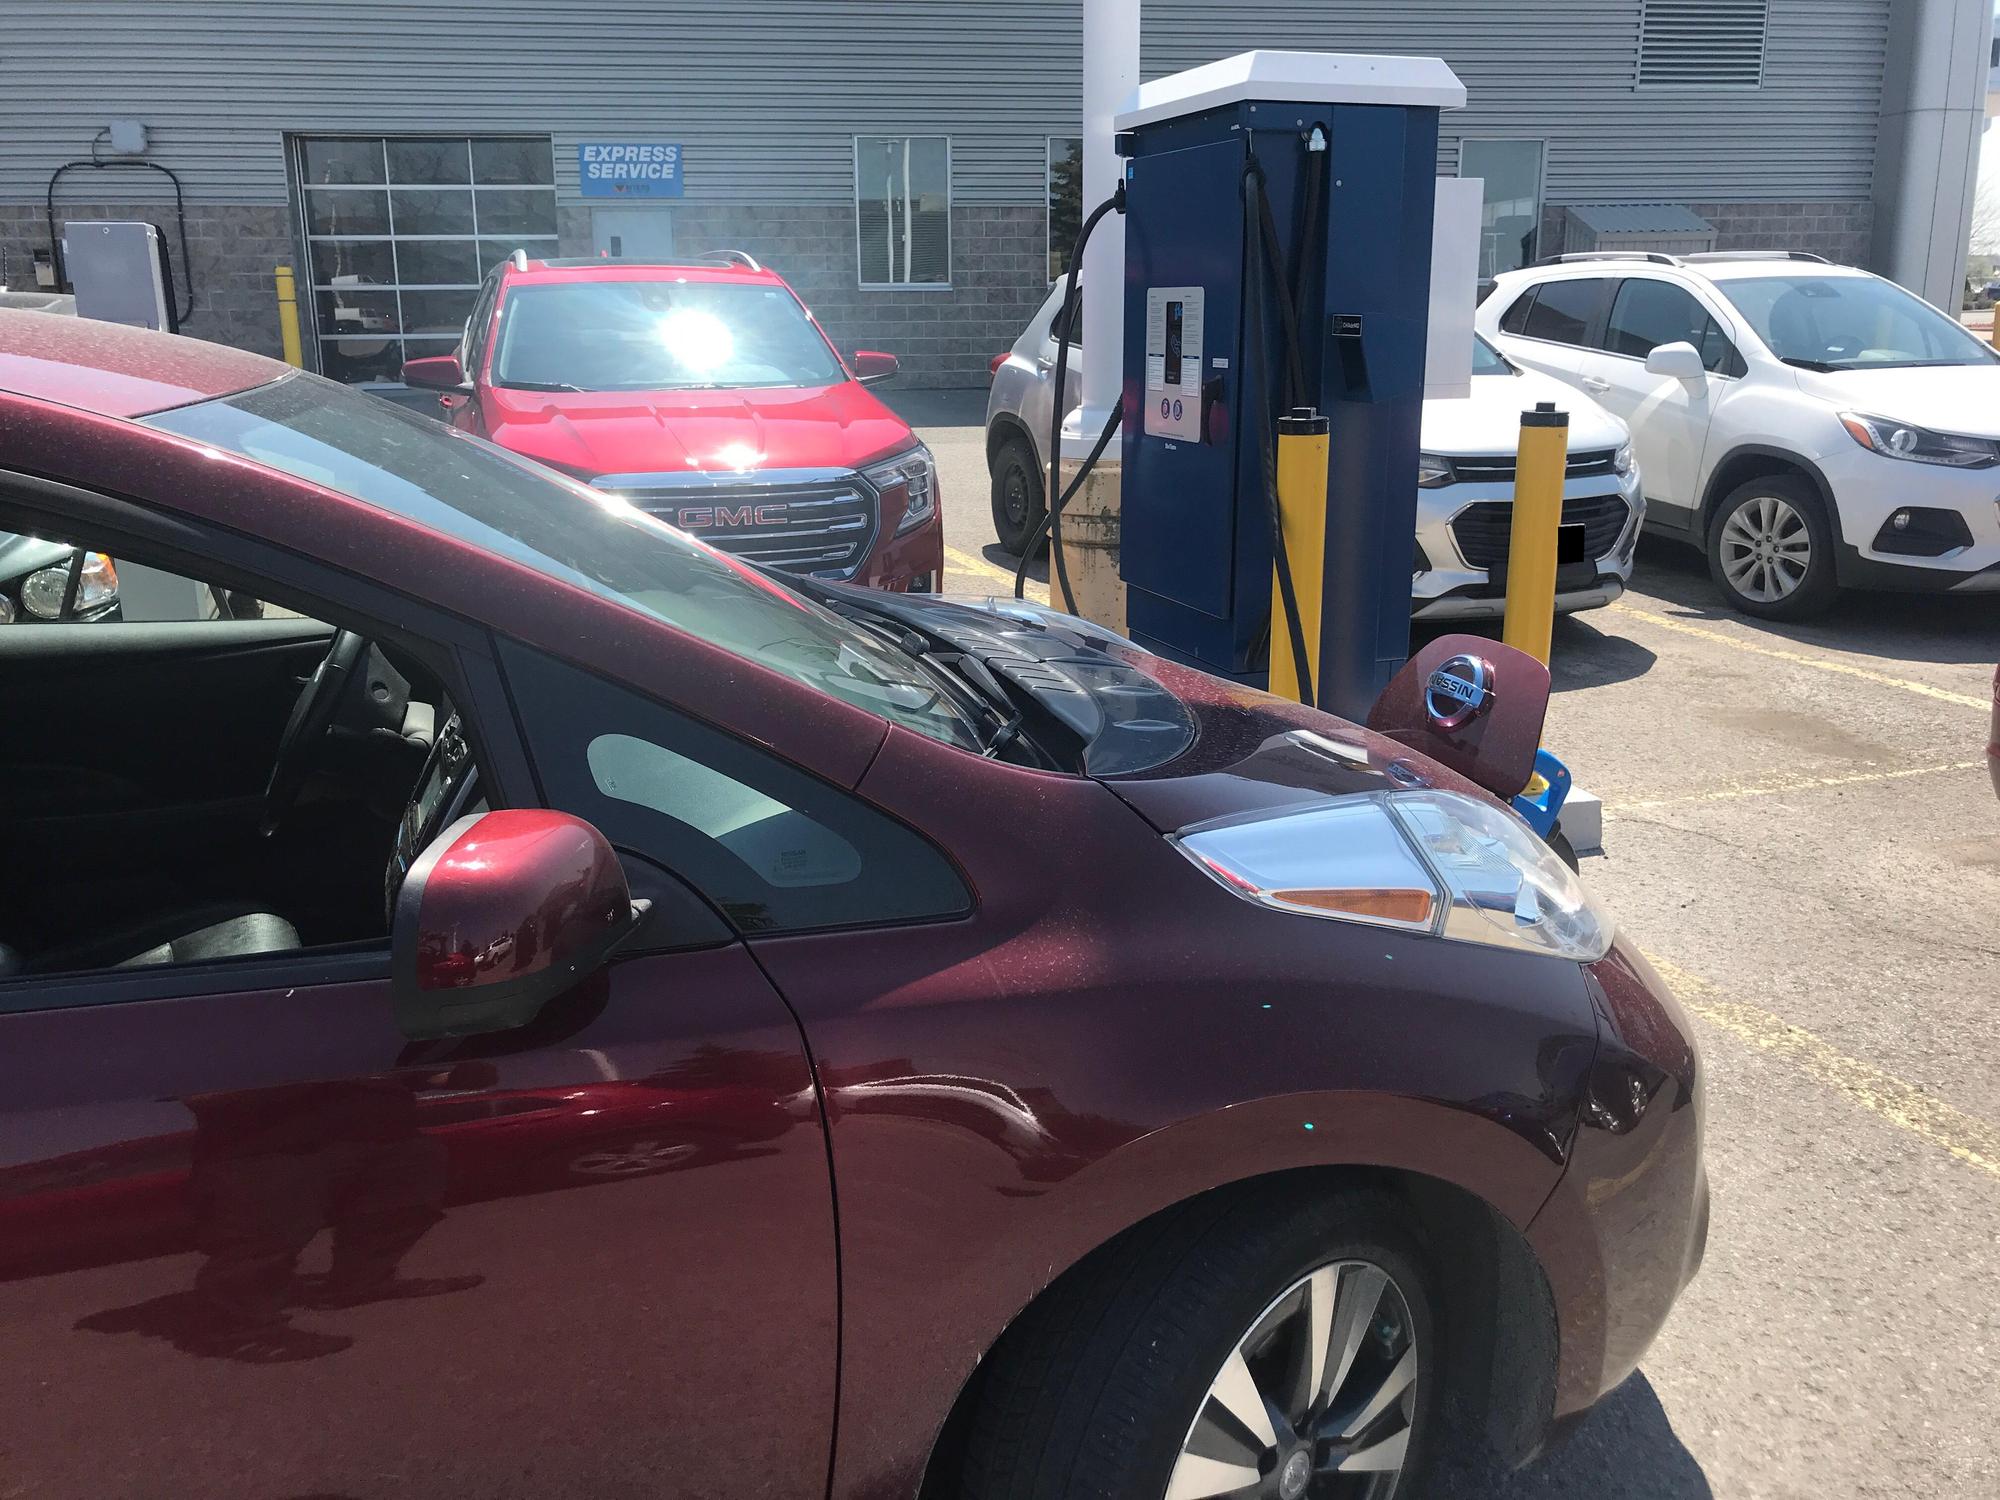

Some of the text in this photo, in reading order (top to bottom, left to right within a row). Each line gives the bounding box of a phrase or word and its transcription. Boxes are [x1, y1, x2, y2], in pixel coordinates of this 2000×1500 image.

[583, 145, 677, 162] EXPRESS
[587, 163, 675, 179] SERVICE
[678, 504, 788, 527] GMC
[1429, 674, 1474, 699] NISSAN
